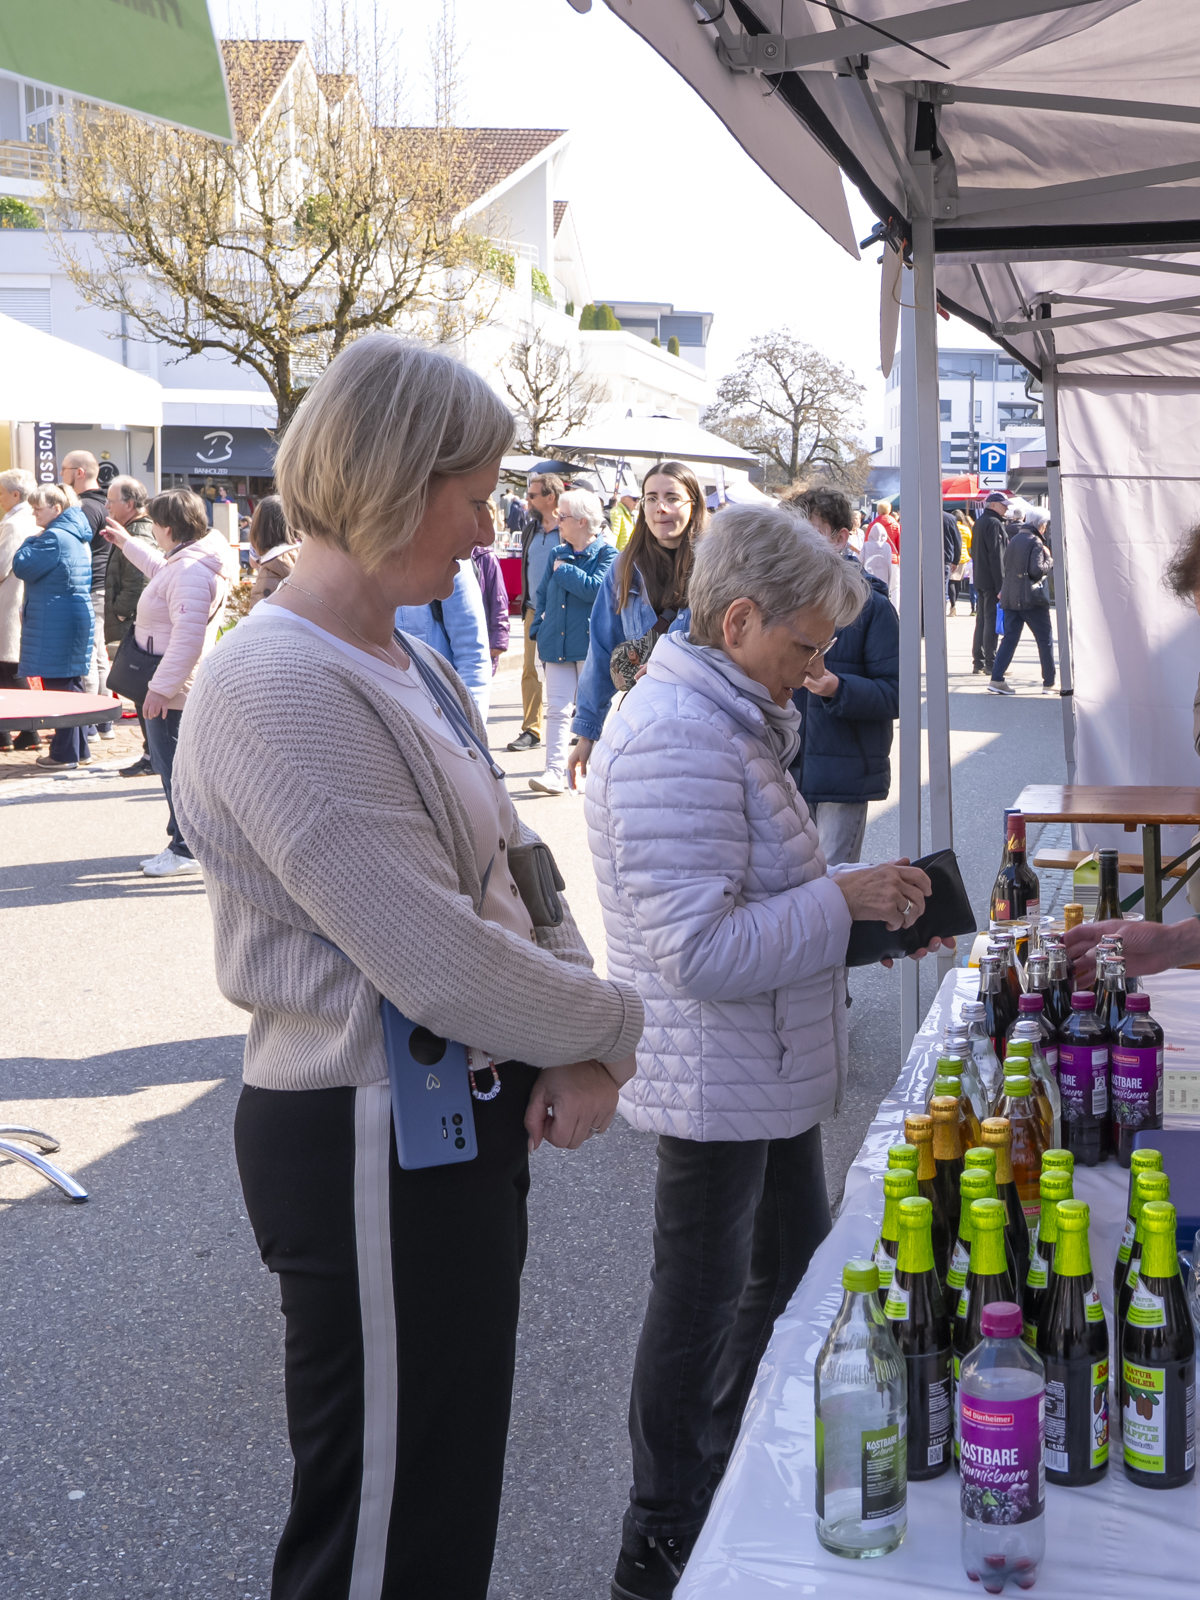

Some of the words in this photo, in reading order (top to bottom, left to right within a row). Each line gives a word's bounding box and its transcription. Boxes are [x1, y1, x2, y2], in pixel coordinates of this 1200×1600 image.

[988, 452, 1000, 470] P
[194, 467, 228, 475] BANHOLZER
[1125, 1371, 1155, 1388] RADLER
[1126, 1364, 1152, 1379] NATUR
[973, 1412, 1012, 1423] Dürrheimer
[866, 1434, 897, 1451] KOSTBARE
